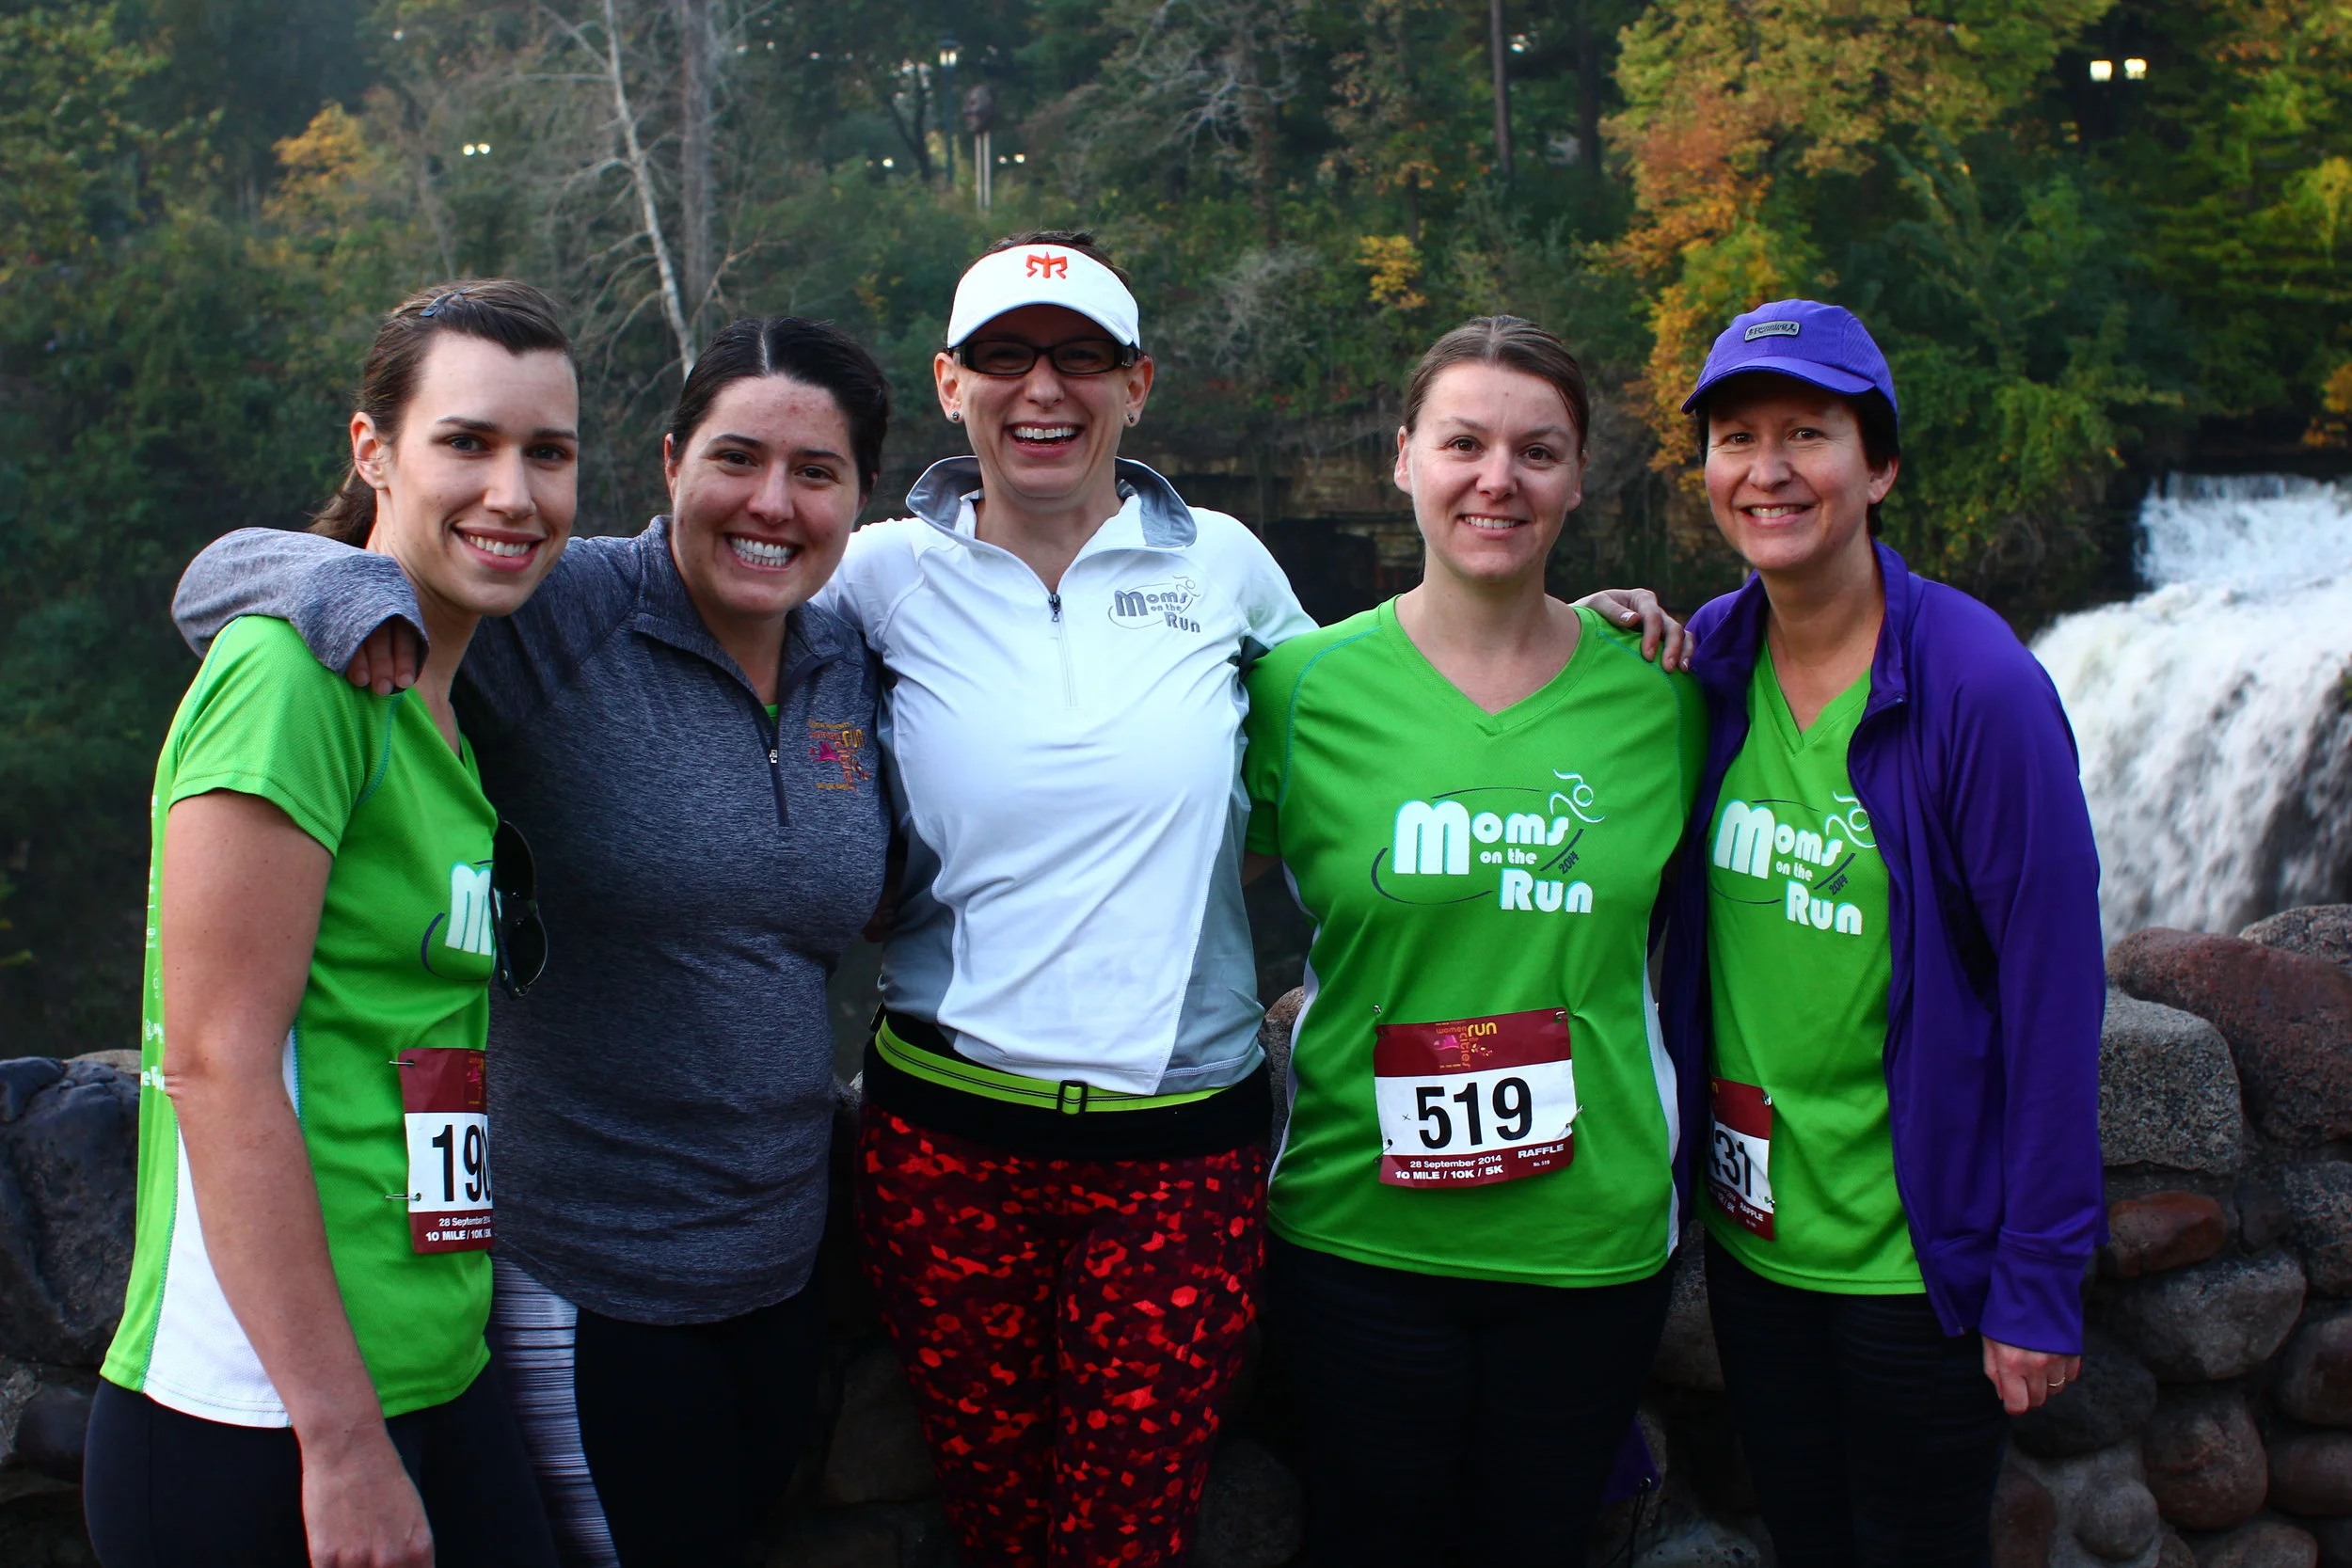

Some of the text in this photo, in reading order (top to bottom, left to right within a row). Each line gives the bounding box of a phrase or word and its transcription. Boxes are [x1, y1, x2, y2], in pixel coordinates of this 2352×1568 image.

[1114, 590, 1188, 617] Moms
[1166, 603, 1183, 611] the
[1164, 611, 1200, 633] Run
[1392, 799, 1569, 875] Moms
[1712, 800, 1843, 879] Moms
[1479, 847, 1537, 864] on the
[1557, 850, 1580, 875] 2014
[1775, 861, 1813, 882] on the
[1499, 866, 1593, 913] Run
[1828, 874, 1850, 896] 2014
[1786, 879, 1863, 936] Run
[1468, 1022, 1498, 1037] run
[1416, 1077, 1533, 1149] 519
[1423, 1159, 1475, 1169] September
[1478, 1154, 1502, 1165] 2014
[1518, 1143, 1565, 1159] RAFFLE
[1395, 1170, 1410, 1180] 10
[1413, 1171, 1440, 1180] MILE
[1450, 1169, 1475, 1179] 10K
[1485, 1164, 1504, 1176] 5K
[438, 1217, 451, 1227] 28
[425, 1231, 439, 1242] 10
[442, 1229, 466, 1241] MILE
[470, 1228, 484, 1239] 10K
